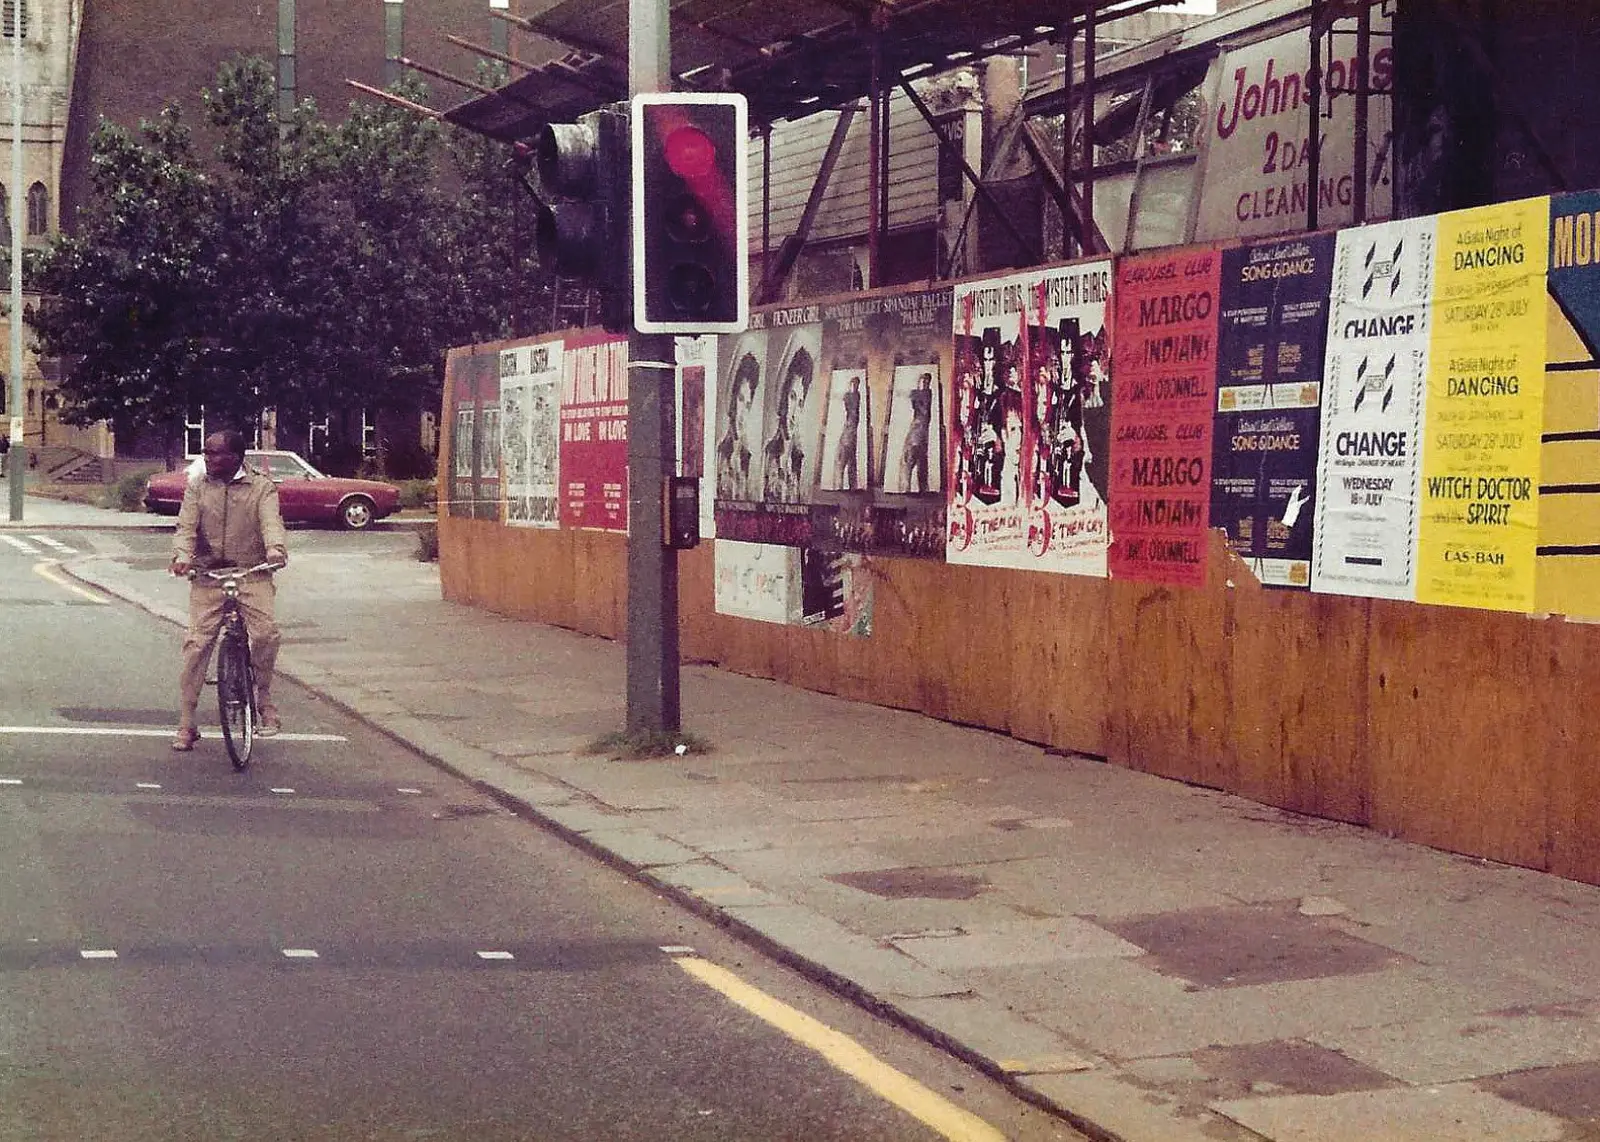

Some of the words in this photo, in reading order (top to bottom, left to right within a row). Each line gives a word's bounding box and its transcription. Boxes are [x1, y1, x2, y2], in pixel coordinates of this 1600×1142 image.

[1263, 131, 1280, 174] 2
[1236, 175, 1352, 220] CLEANNG
[1485, 226, 1510, 246] Night
[1511, 222, 1523, 239] of
[1184, 257, 1213, 277] CLUB
[1241, 263, 1272, 282] SONG
[1281, 258, 1316, 277] DANCE
[1454, 244, 1525, 272] DANCING
[1083, 270, 1108, 304] GIRLS
[1139, 291, 1213, 328] MARGO
[1447, 376, 1519, 397] DANCING
[608, 419, 628, 440] LOVE
[1232, 435, 1258, 452] SONG
[1268, 433, 1301, 451] DANCE
[1336, 431, 1407, 457] CHANGE
[1132, 457, 1204, 488] MARGO
[1343, 477, 1394, 491] WEDNESDAY
[1364, 493, 1384, 506] JULY
[1427, 477, 1472, 500] WITCH
[1477, 477, 1531, 501] DOCTOR
[1467, 502, 1511, 526] SPIRIT
